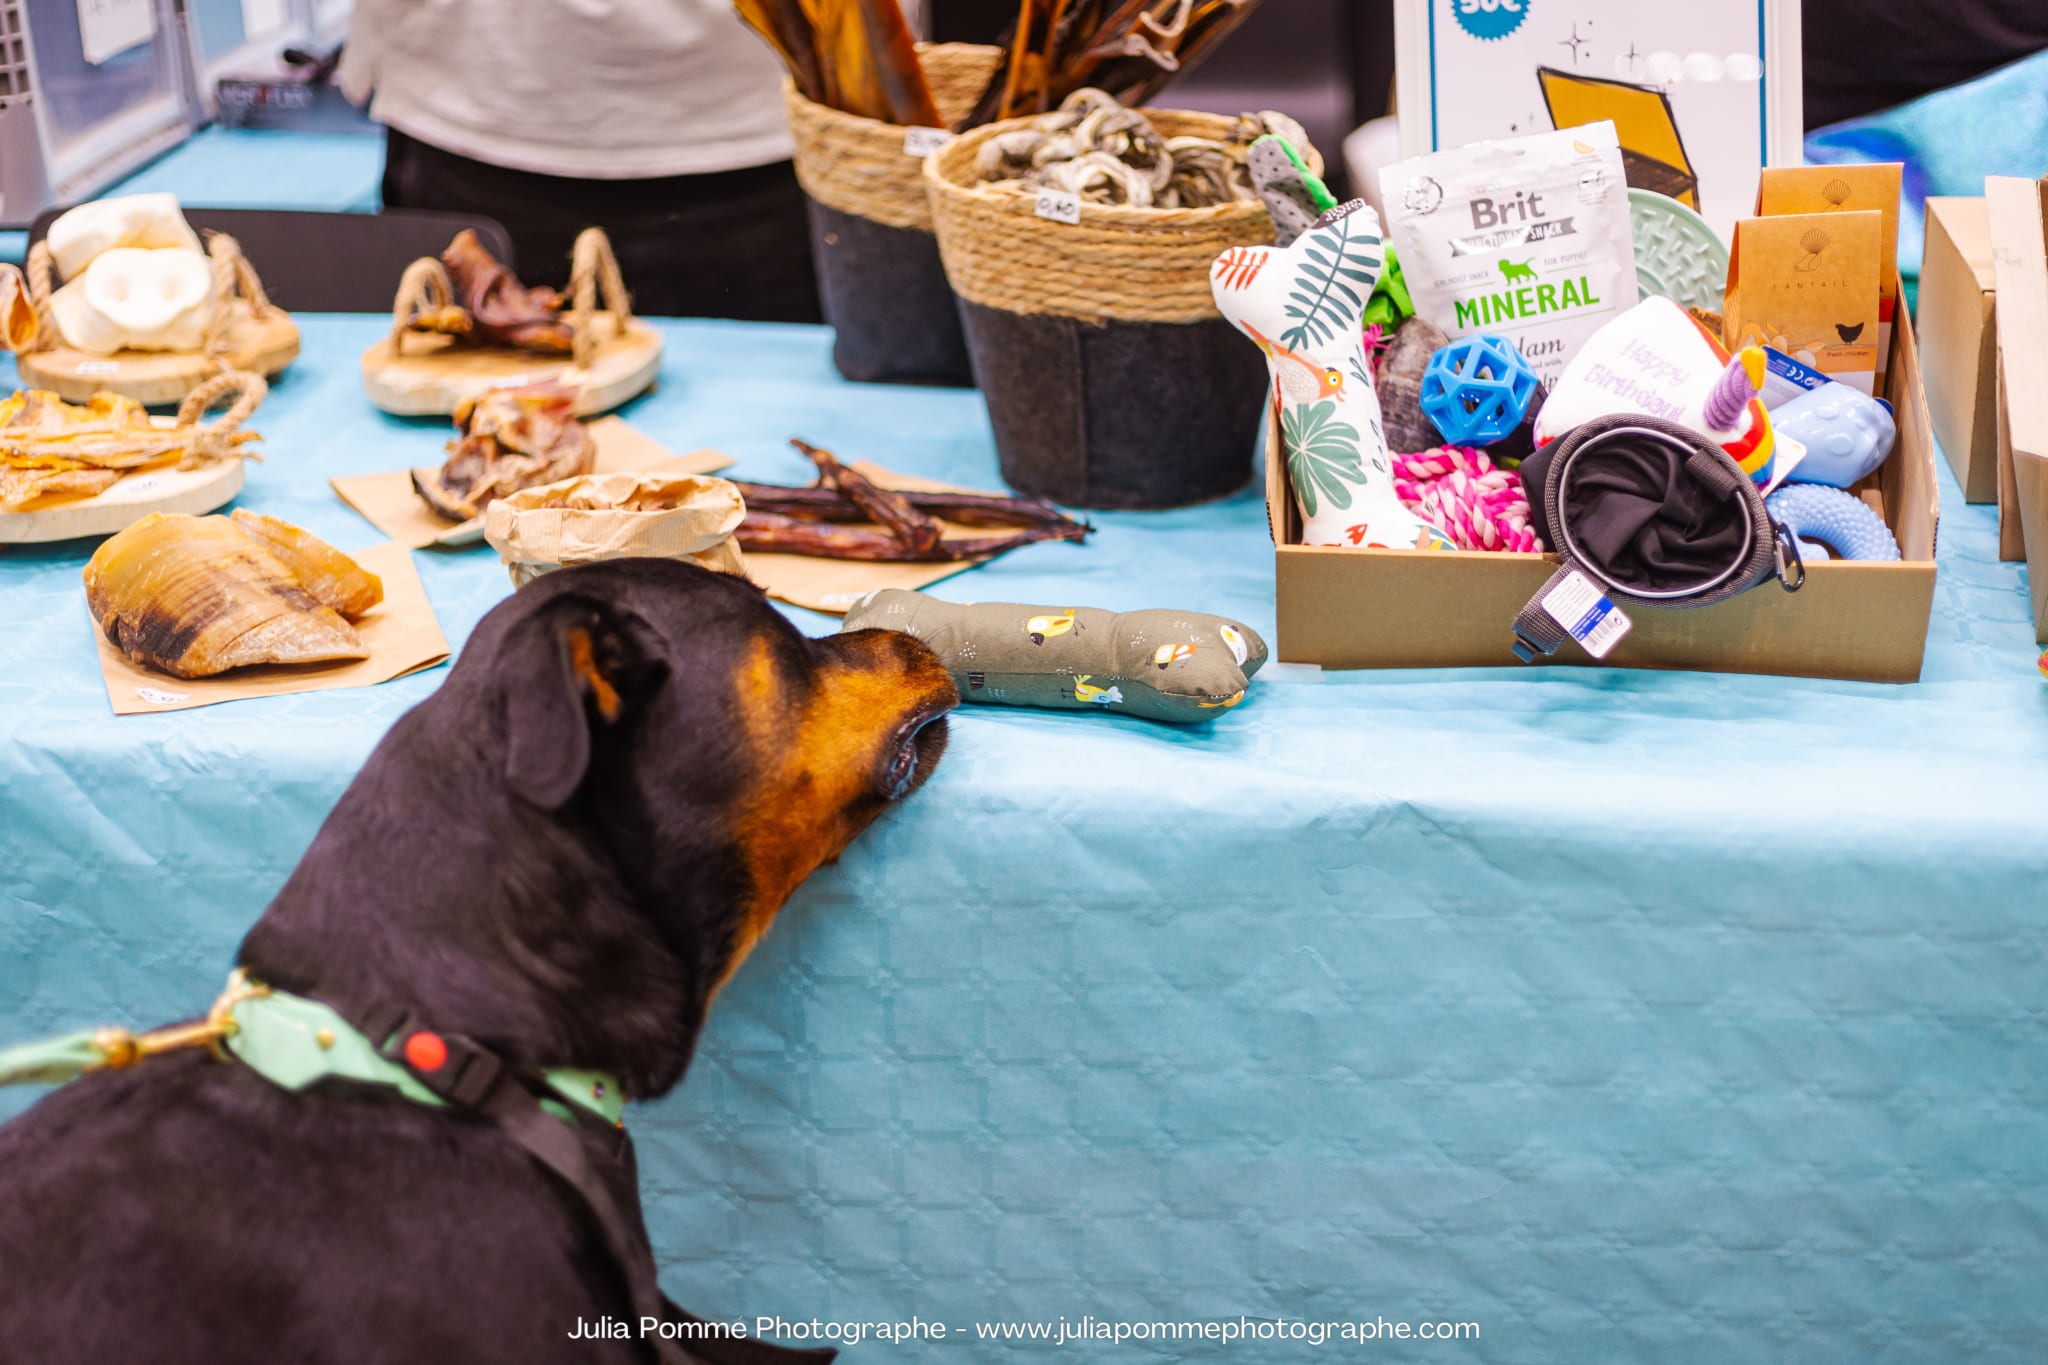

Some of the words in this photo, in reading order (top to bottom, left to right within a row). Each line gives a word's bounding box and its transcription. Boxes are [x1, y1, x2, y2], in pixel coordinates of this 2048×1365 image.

[1470, 191, 1546, 230] Brit
[1455, 277, 1600, 328] MINERAL
[1620, 338, 1691, 387] Happy
